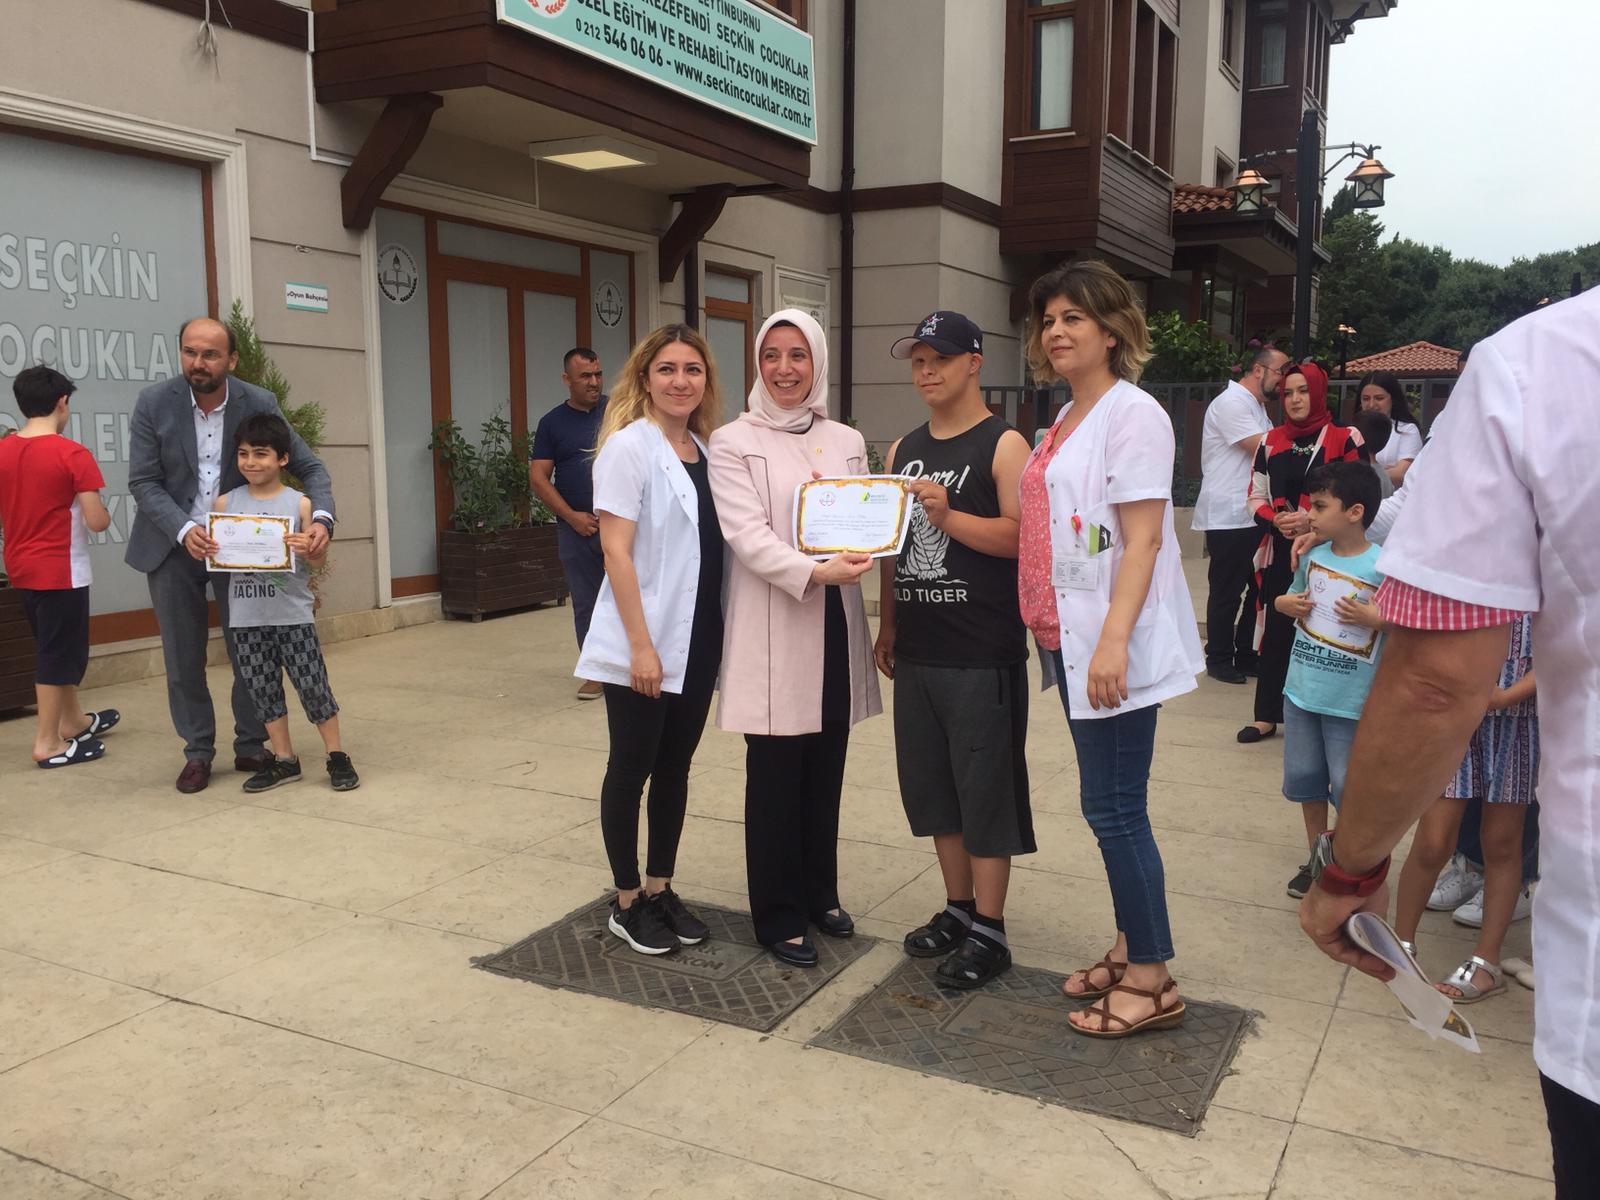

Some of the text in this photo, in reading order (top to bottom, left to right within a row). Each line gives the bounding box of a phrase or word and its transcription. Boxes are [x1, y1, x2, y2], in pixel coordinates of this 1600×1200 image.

[576, 18, 582, 32] 0
[584, 22, 601, 41] 212
[603, 24, 627, 51] 546
[631, 37, 646, 59] 06
[648, 45, 664, 67] 06
[674, 60, 812, 128] www.seckincocuklar.com.tr
[613, 1, 658, 39] EĞİTİM
[660, 23, 676, 47] VE
[678, 32, 769, 88] REHABİLİTASYON
[771, 75, 810, 107] MERKEZİ
[717, 22, 755, 55] SEÇKİN
[760, 44, 809, 81] ÇOCUKLAR
[0, 232, 160, 310] SEÇKİN
[0, 321, 182, 382] OCUKLA
[915, 588, 968, 603] TIGER
[1317, 658, 1358, 671] RUNNER
